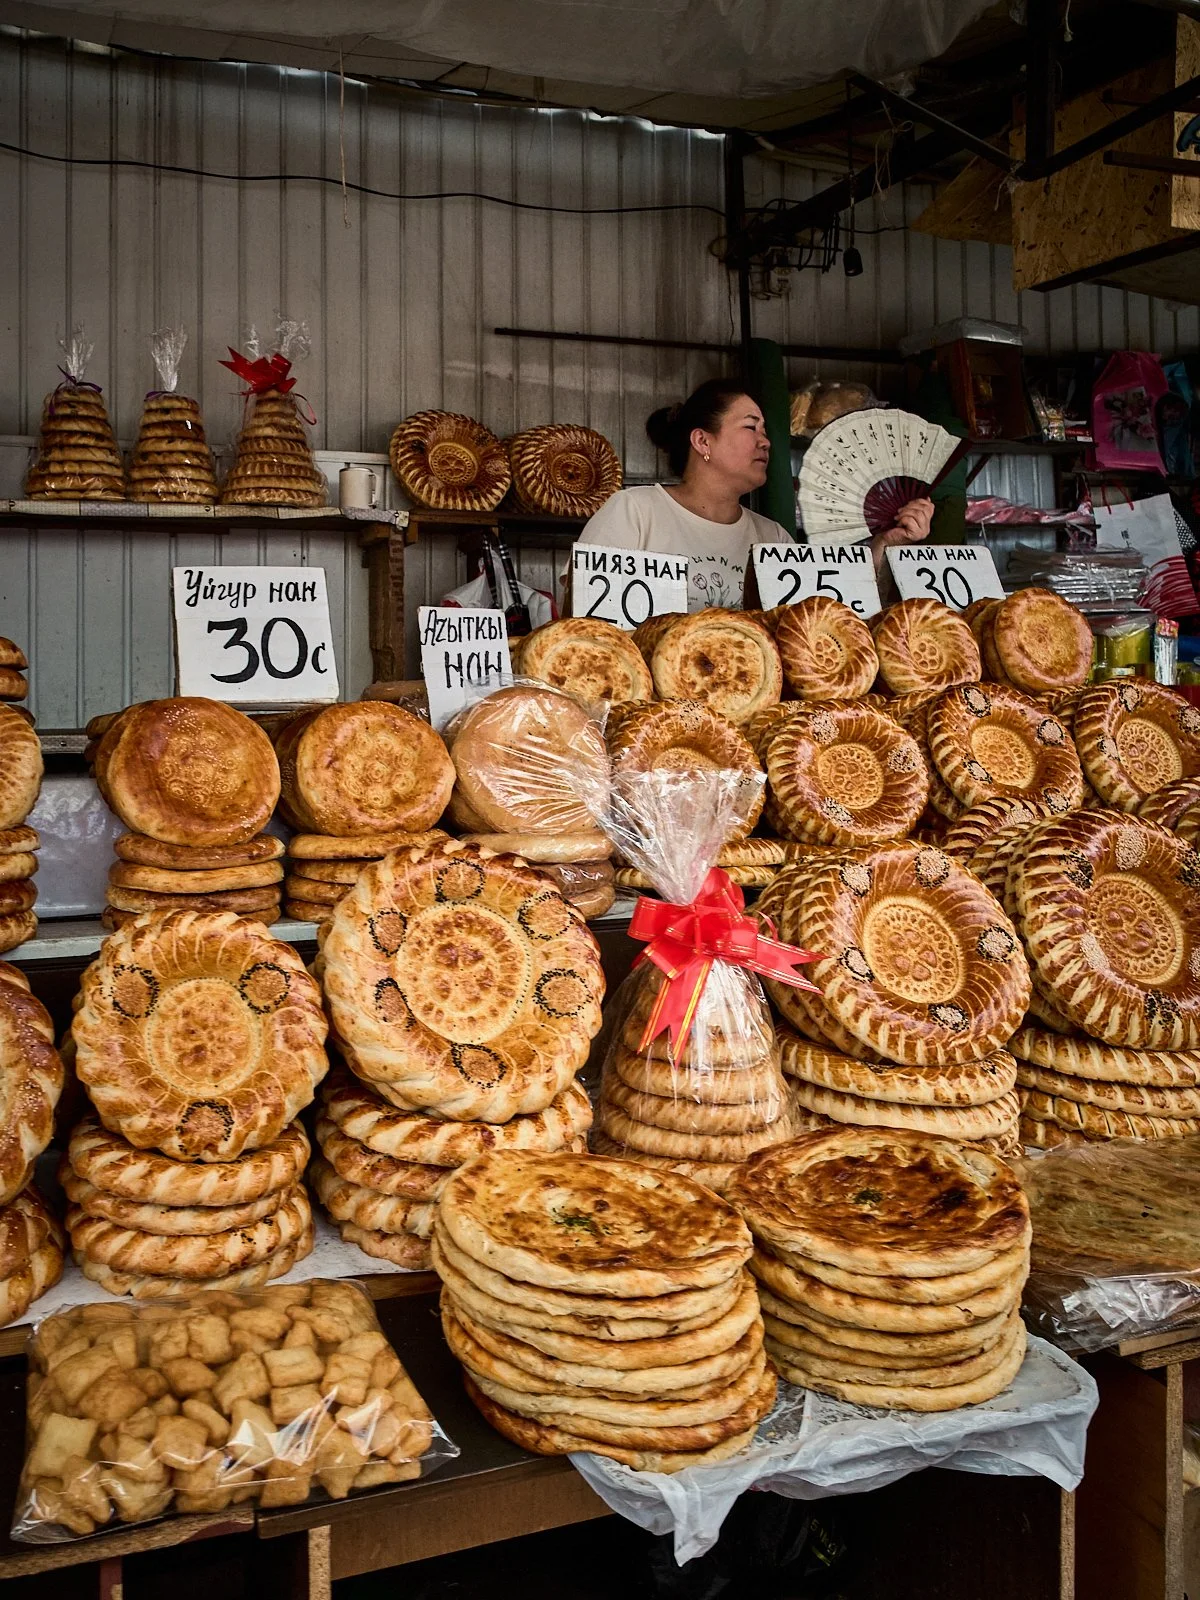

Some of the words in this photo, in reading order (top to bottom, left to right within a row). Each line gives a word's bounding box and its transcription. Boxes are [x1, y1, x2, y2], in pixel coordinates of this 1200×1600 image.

[574, 550, 637, 575] ПИЯЗ
[644, 557, 689, 581] НАН
[760, 545, 816, 564] МАЙ
[821, 546, 867, 564] НАН
[899, 546, 938, 561] МАЙ
[944, 548, 977, 561] НАН
[184, 569, 257, 609] Уйгур
[269, 581, 317, 604] нан
[585, 574, 654, 629] 20
[915, 566, 974, 610] 30
